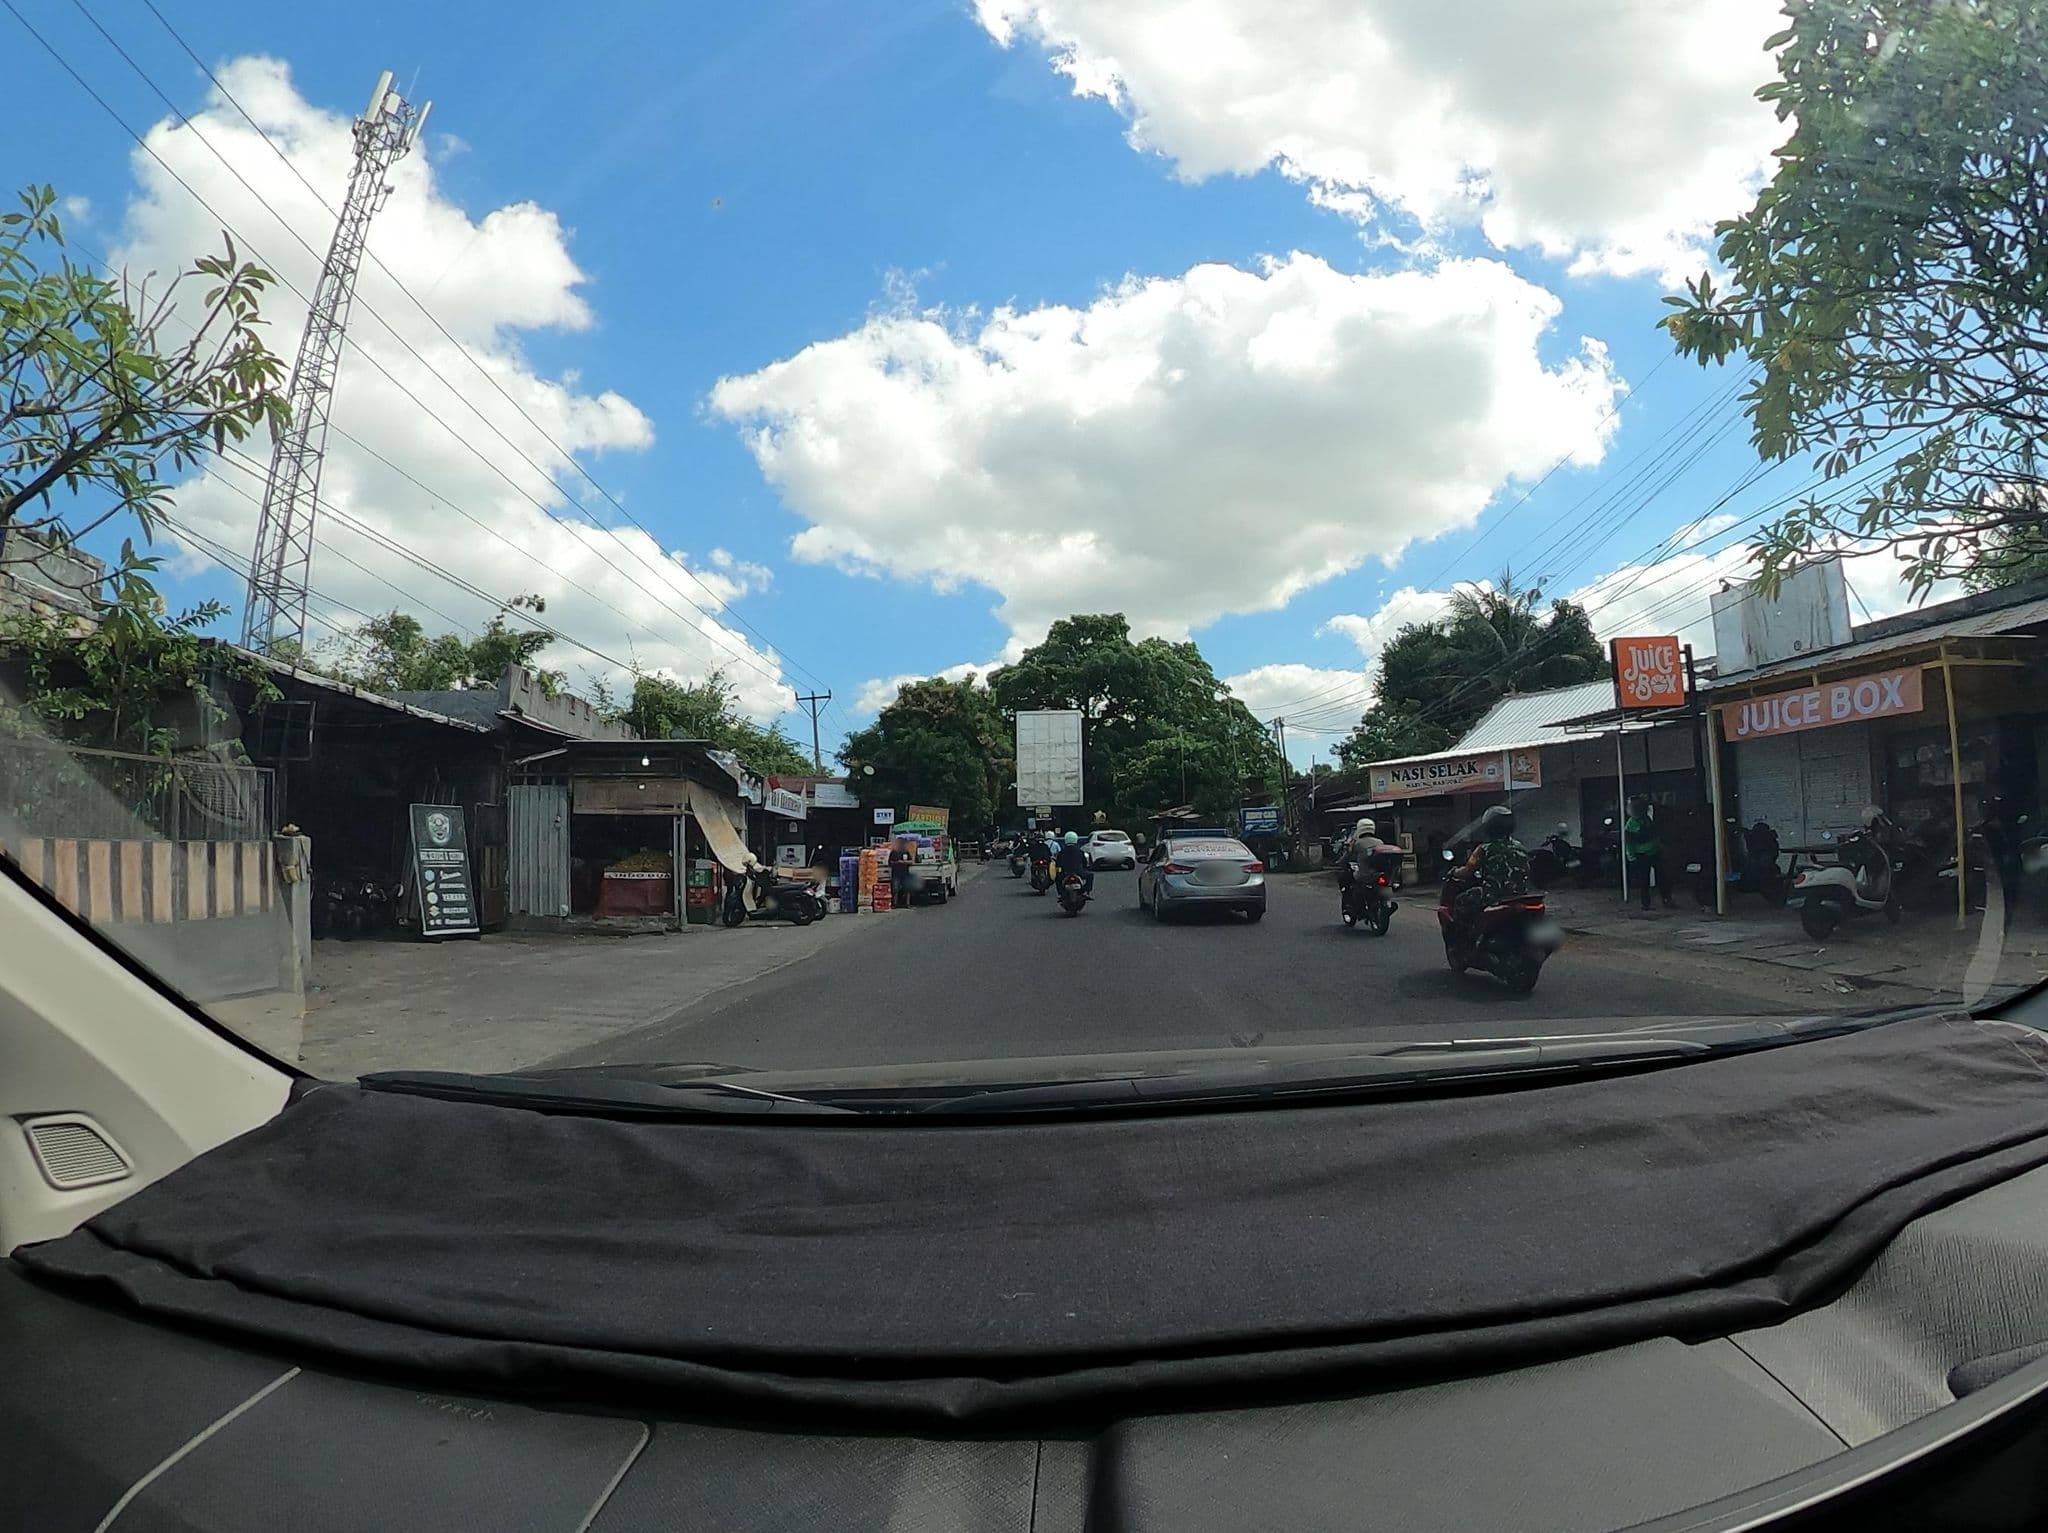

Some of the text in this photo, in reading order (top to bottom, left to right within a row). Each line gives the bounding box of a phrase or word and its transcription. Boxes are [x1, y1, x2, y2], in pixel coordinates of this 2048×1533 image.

[1636, 673, 1676, 701] BOX
[1737, 675, 1904, 735] JUICE BOX
[1391, 761, 1478, 782] NASI SELAK
